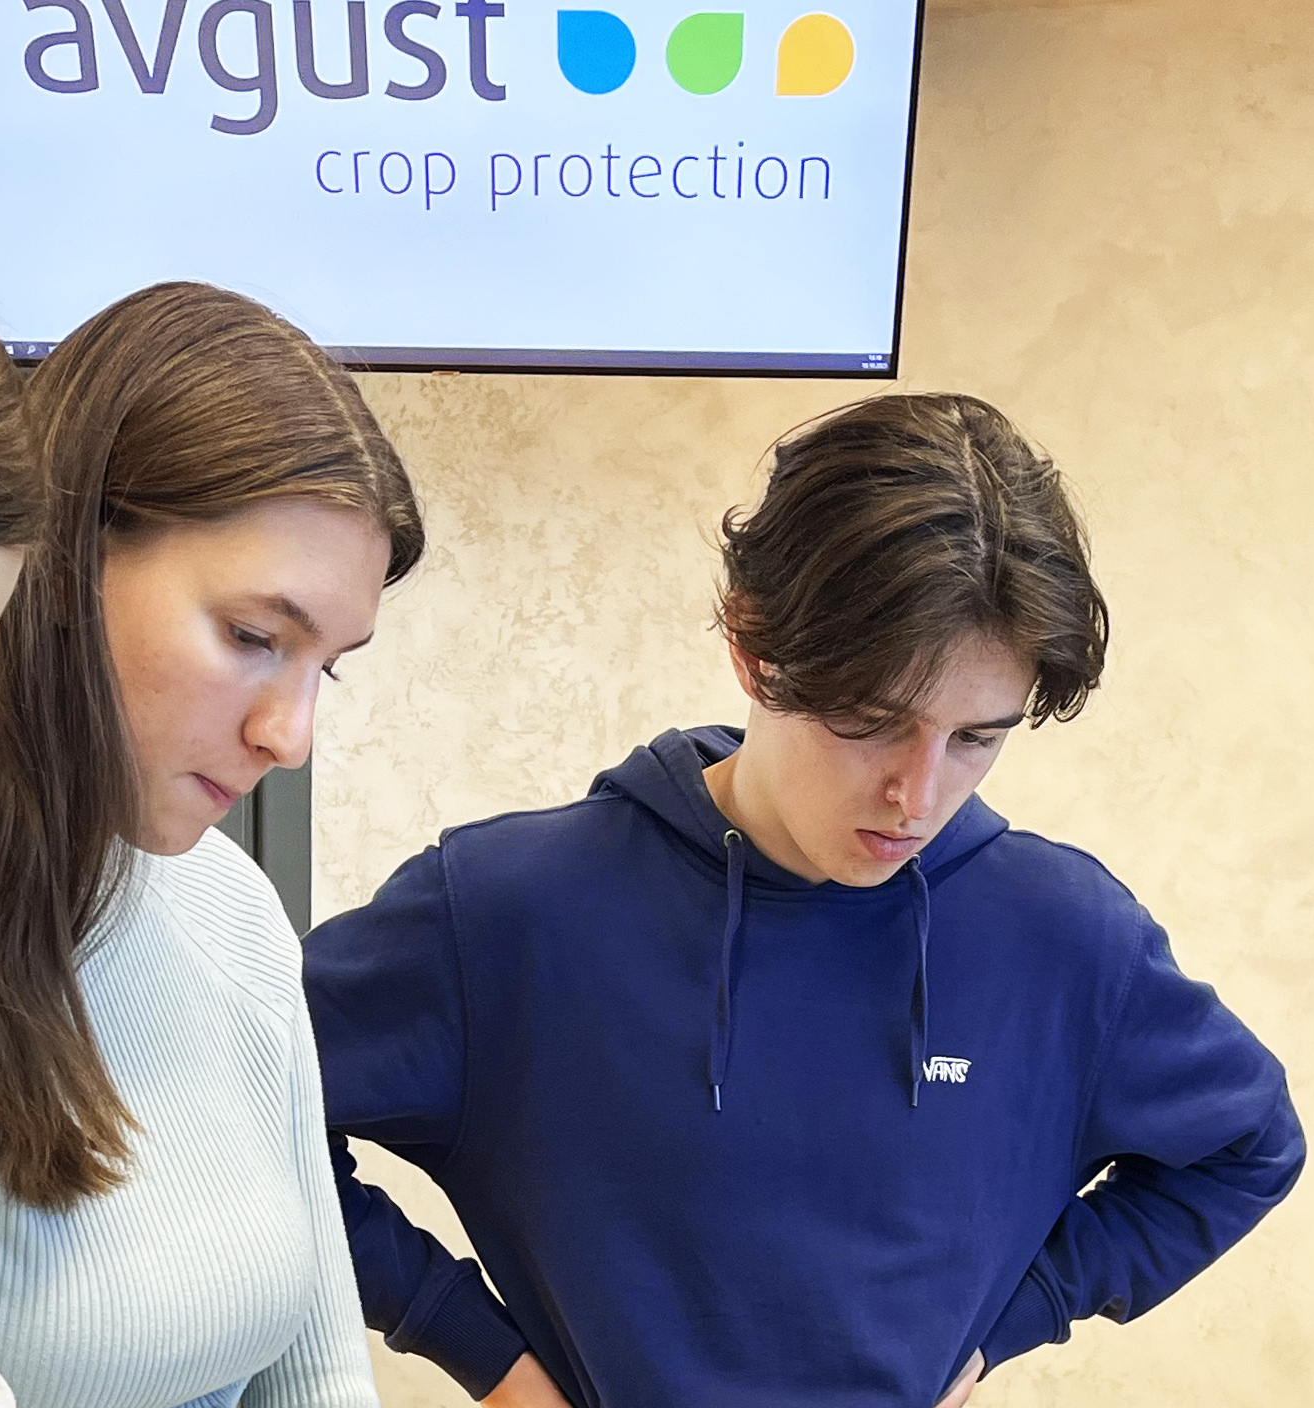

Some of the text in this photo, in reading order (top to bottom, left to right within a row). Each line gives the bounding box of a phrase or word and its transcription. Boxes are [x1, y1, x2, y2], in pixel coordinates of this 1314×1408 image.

[24, 0, 507, 136] avgust
[315, 141, 831, 212] crop protection
[922, 1056, 972, 1084] VANS
